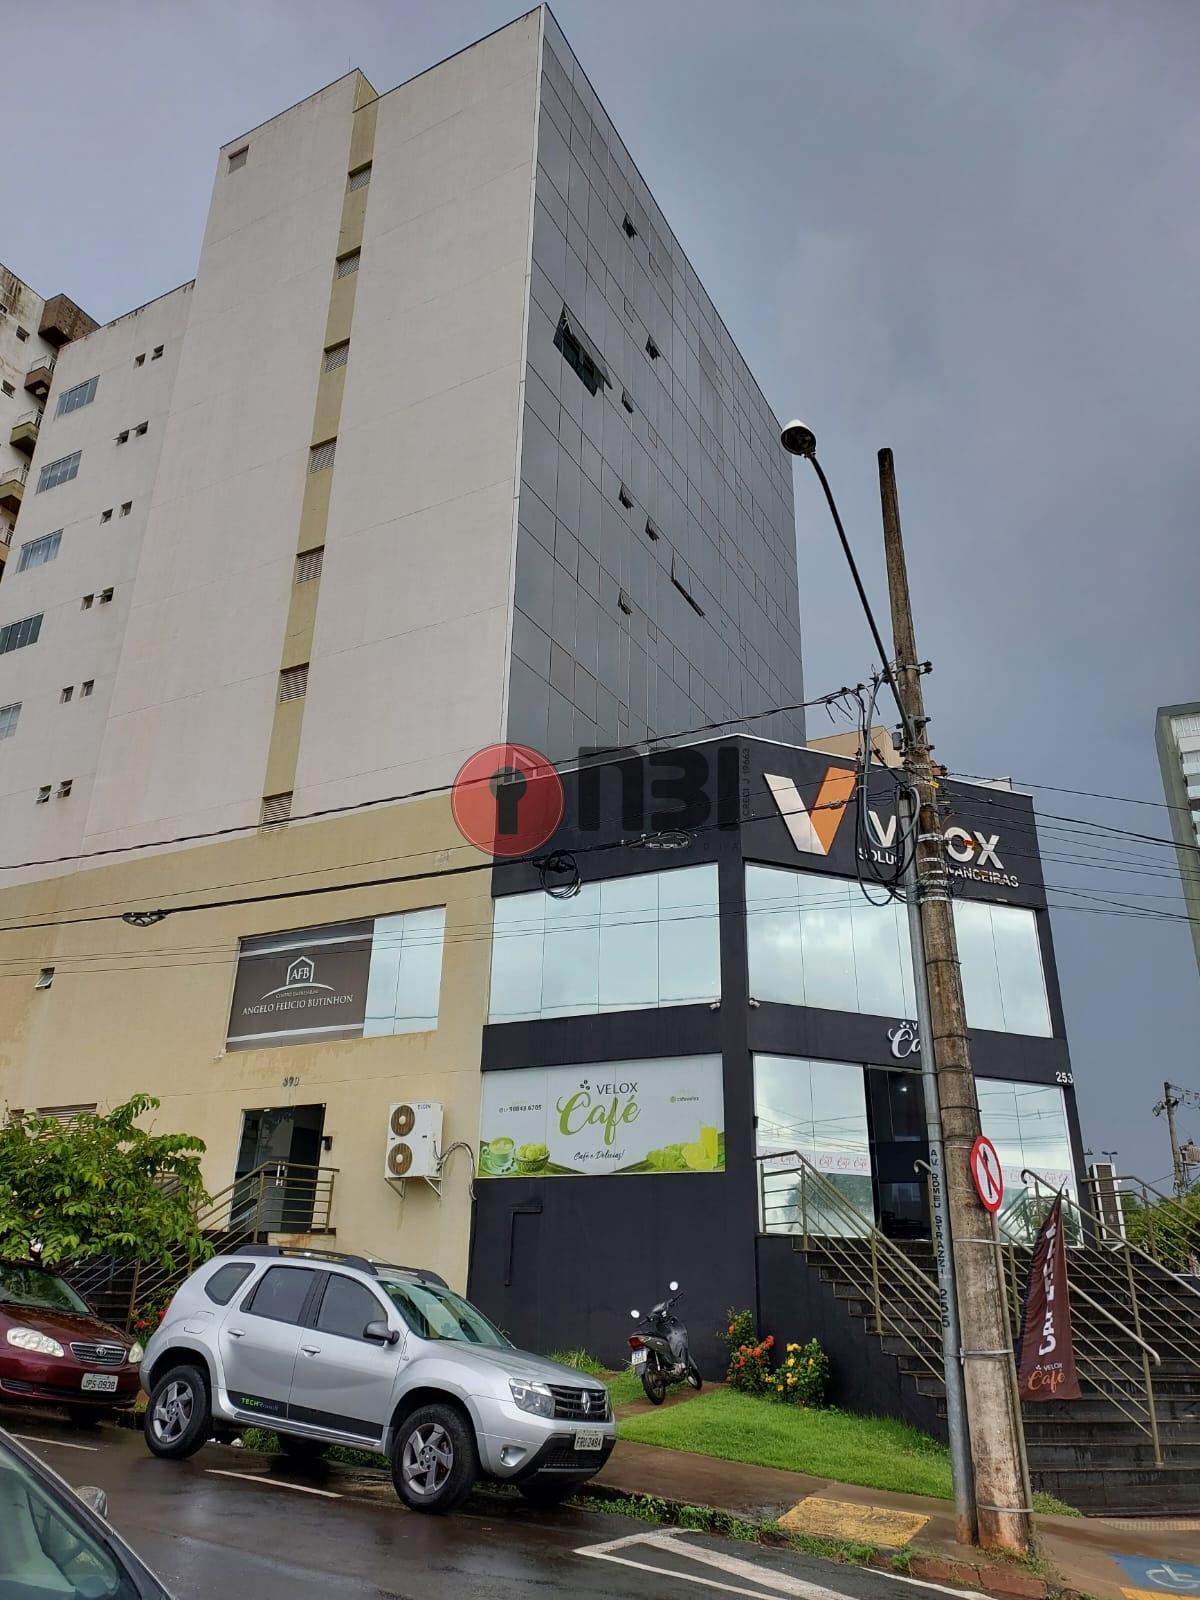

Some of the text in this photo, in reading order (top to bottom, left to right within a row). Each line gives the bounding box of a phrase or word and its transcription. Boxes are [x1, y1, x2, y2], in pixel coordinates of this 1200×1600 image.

[868, 810, 1004, 869] VOX
[289, 967, 310, 980] AFB
[242, 1003, 274, 1016] ANGELO
[307, 994, 354, 1008] BUTINHON
[888, 1028, 921, 1058] Ca
[596, 1082, 638, 1095] VELOX
[1055, 1071, 1074, 1084] 253
[556, 1091, 641, 1146] Café
